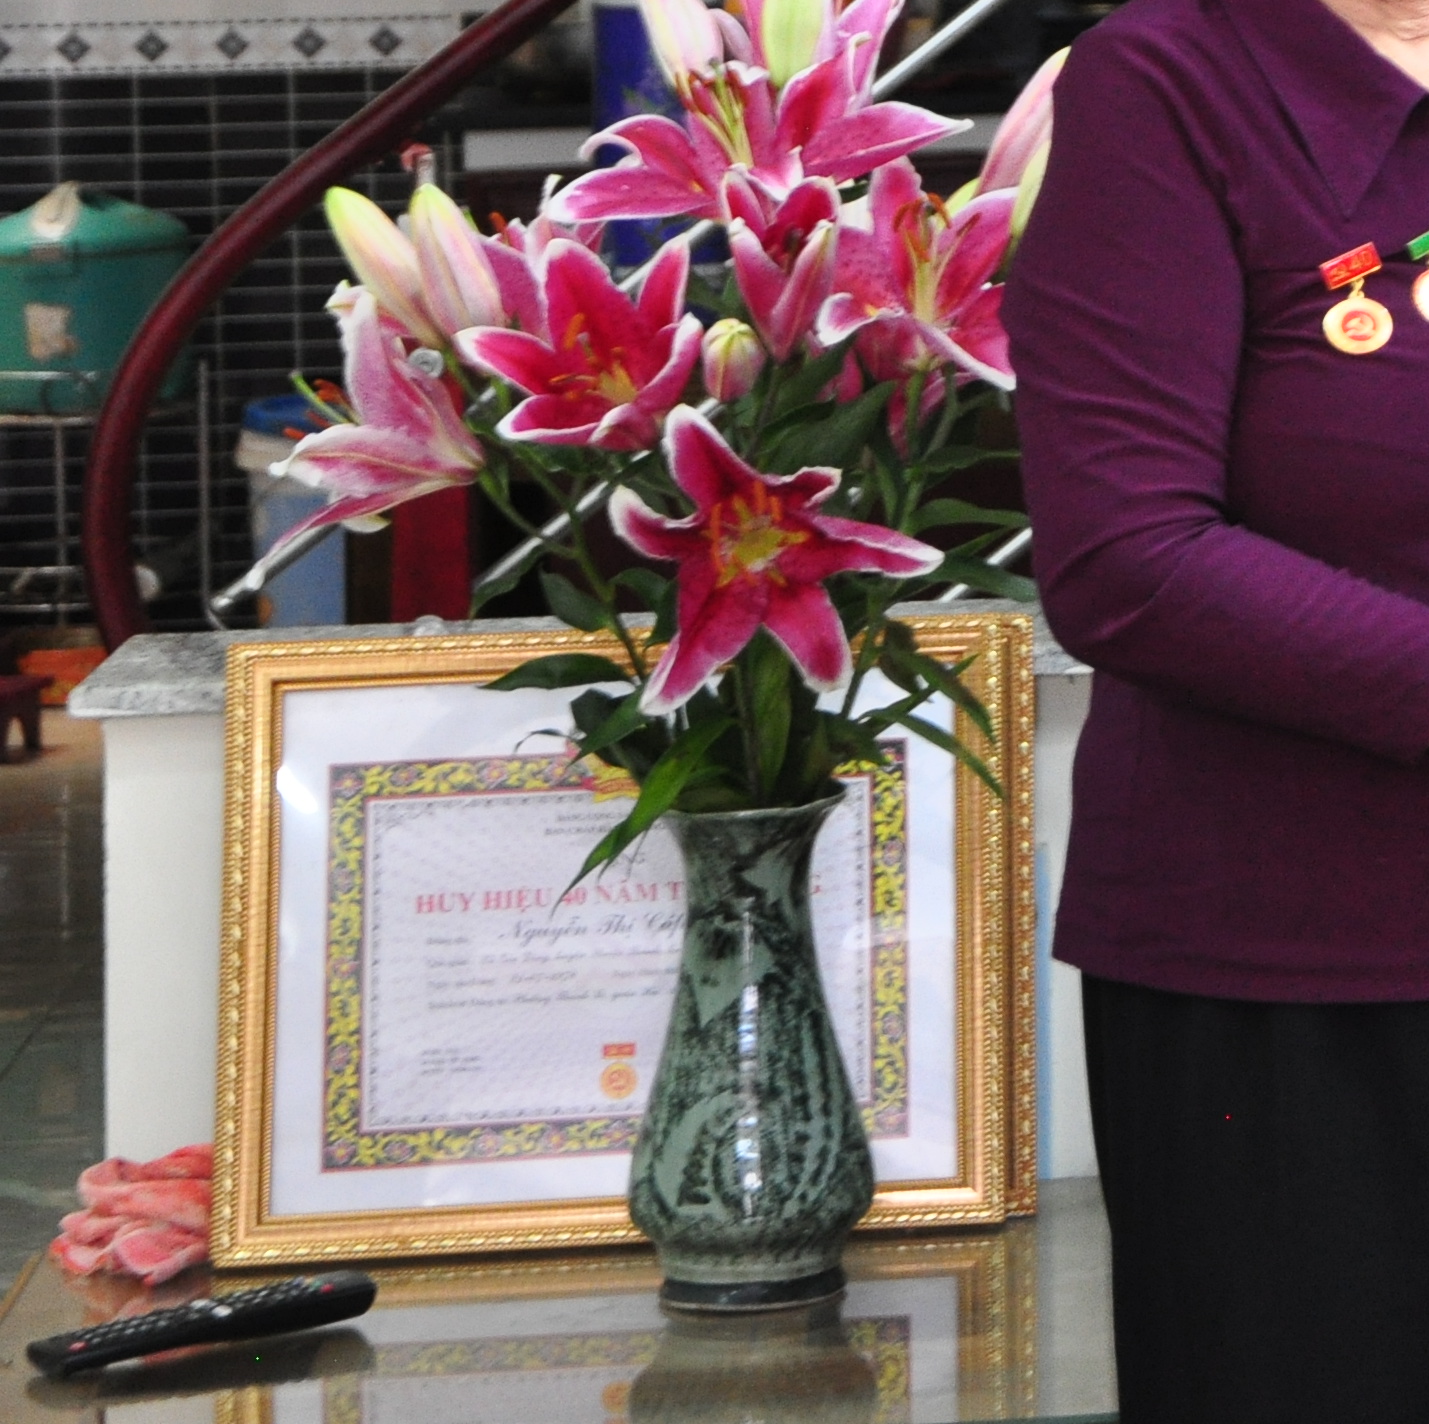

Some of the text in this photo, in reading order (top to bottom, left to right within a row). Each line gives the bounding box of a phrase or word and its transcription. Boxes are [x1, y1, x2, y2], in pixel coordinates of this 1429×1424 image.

[415, 893, 475, 915] HUY
[483, 886, 553, 912] HIỆU
[562, 887, 587, 906] 40
